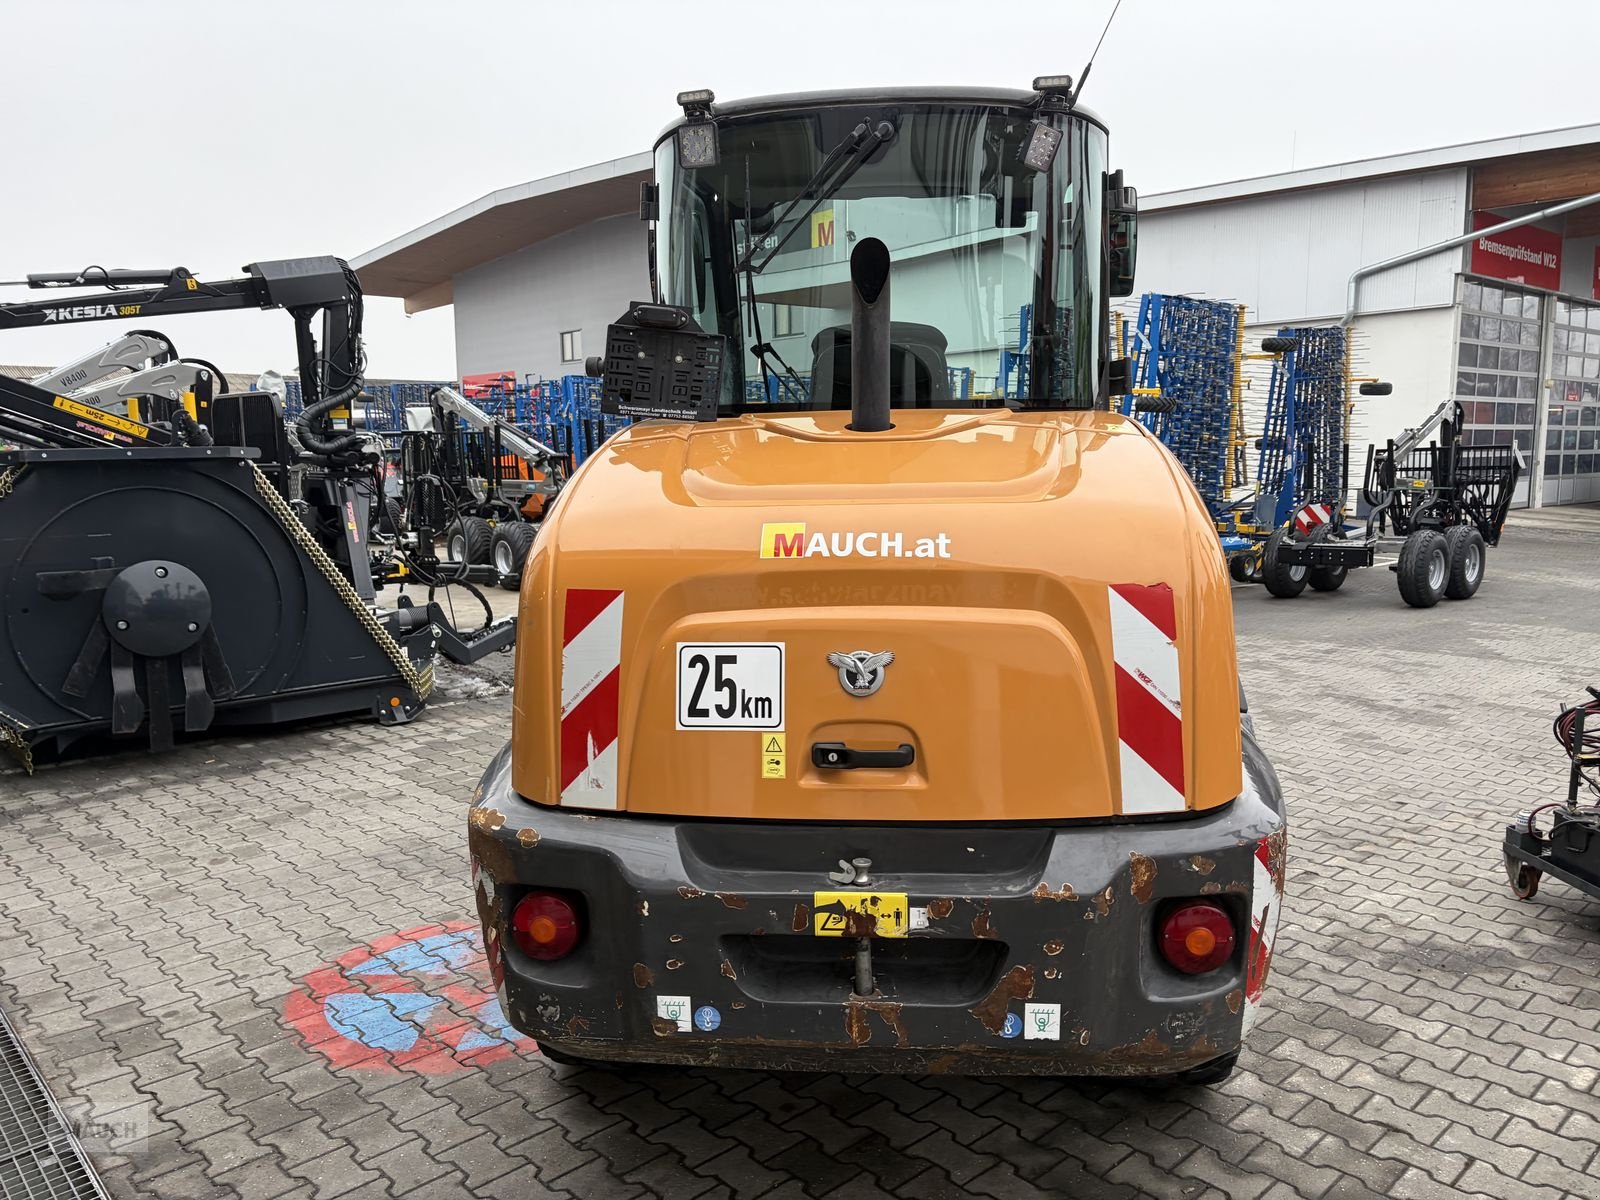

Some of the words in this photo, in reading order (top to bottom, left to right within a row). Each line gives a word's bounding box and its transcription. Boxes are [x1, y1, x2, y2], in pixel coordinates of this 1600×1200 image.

[1479, 236, 1542, 264] Bremsenprüfstand
[1543, 251, 1557, 269] W12
[58, 304, 118, 321] KESLA
[119, 305, 141, 316] 305T
[60, 369, 88, 387] V8400
[773, 532, 952, 559] MAUCH.at
[687, 653, 738, 719] 25
[740, 688, 773, 719] km
